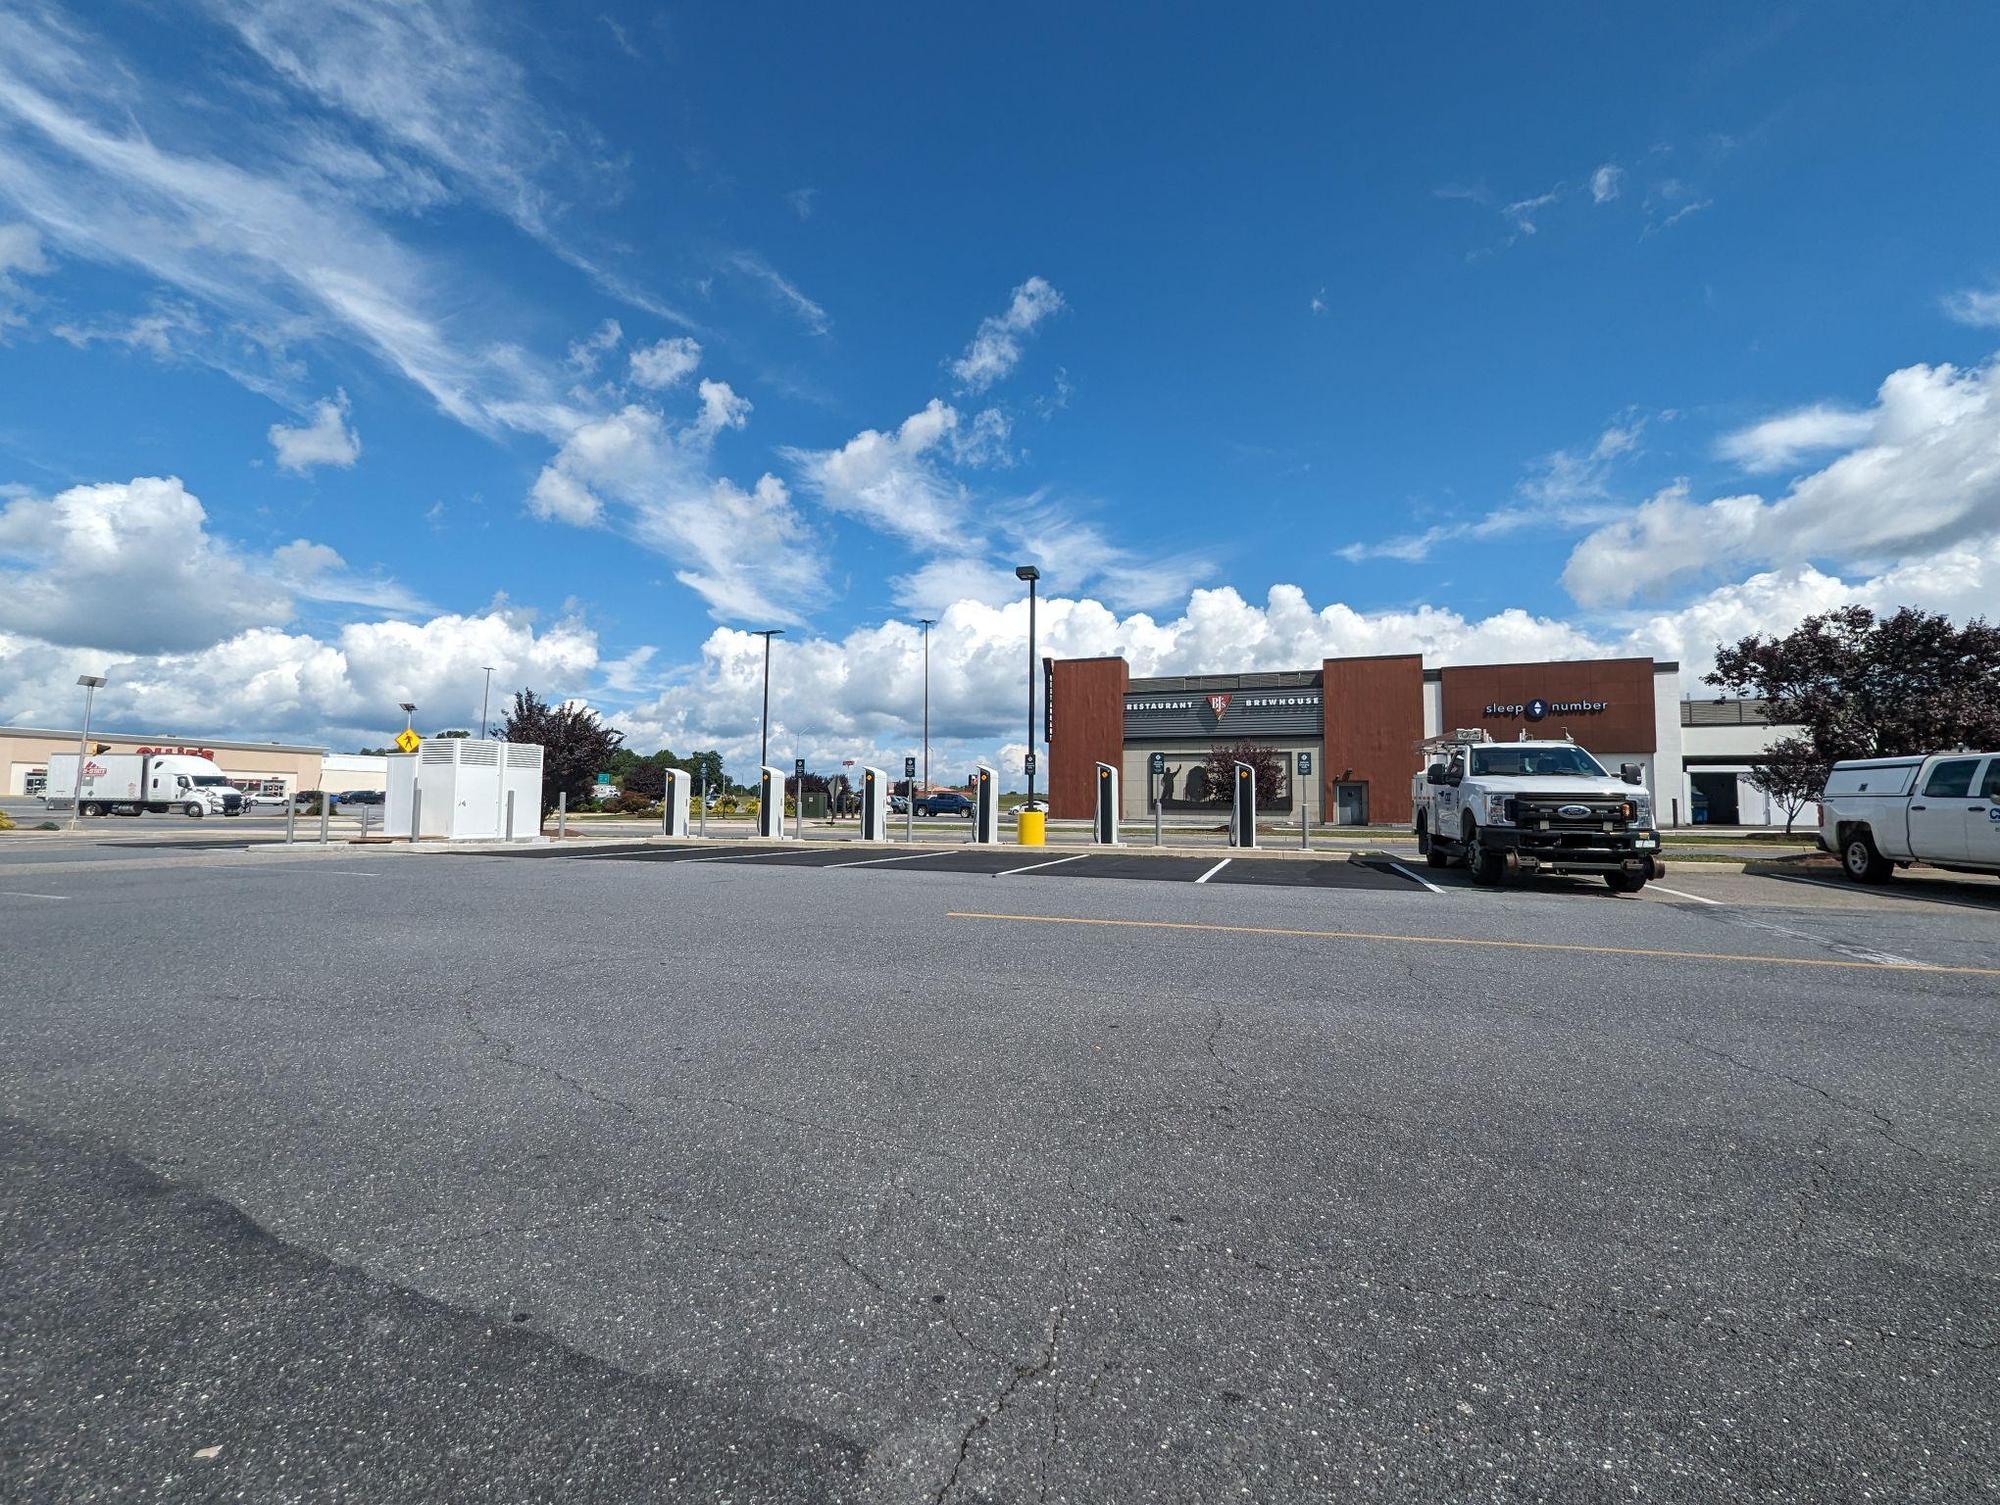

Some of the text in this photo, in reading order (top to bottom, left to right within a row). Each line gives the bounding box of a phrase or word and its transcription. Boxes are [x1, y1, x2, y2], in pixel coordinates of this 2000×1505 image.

[1126, 701, 1193, 710] RESTAURANT
[1245, 697, 1319, 706] BREWHOUSE
[1486, 700, 1608, 715] sleep number
